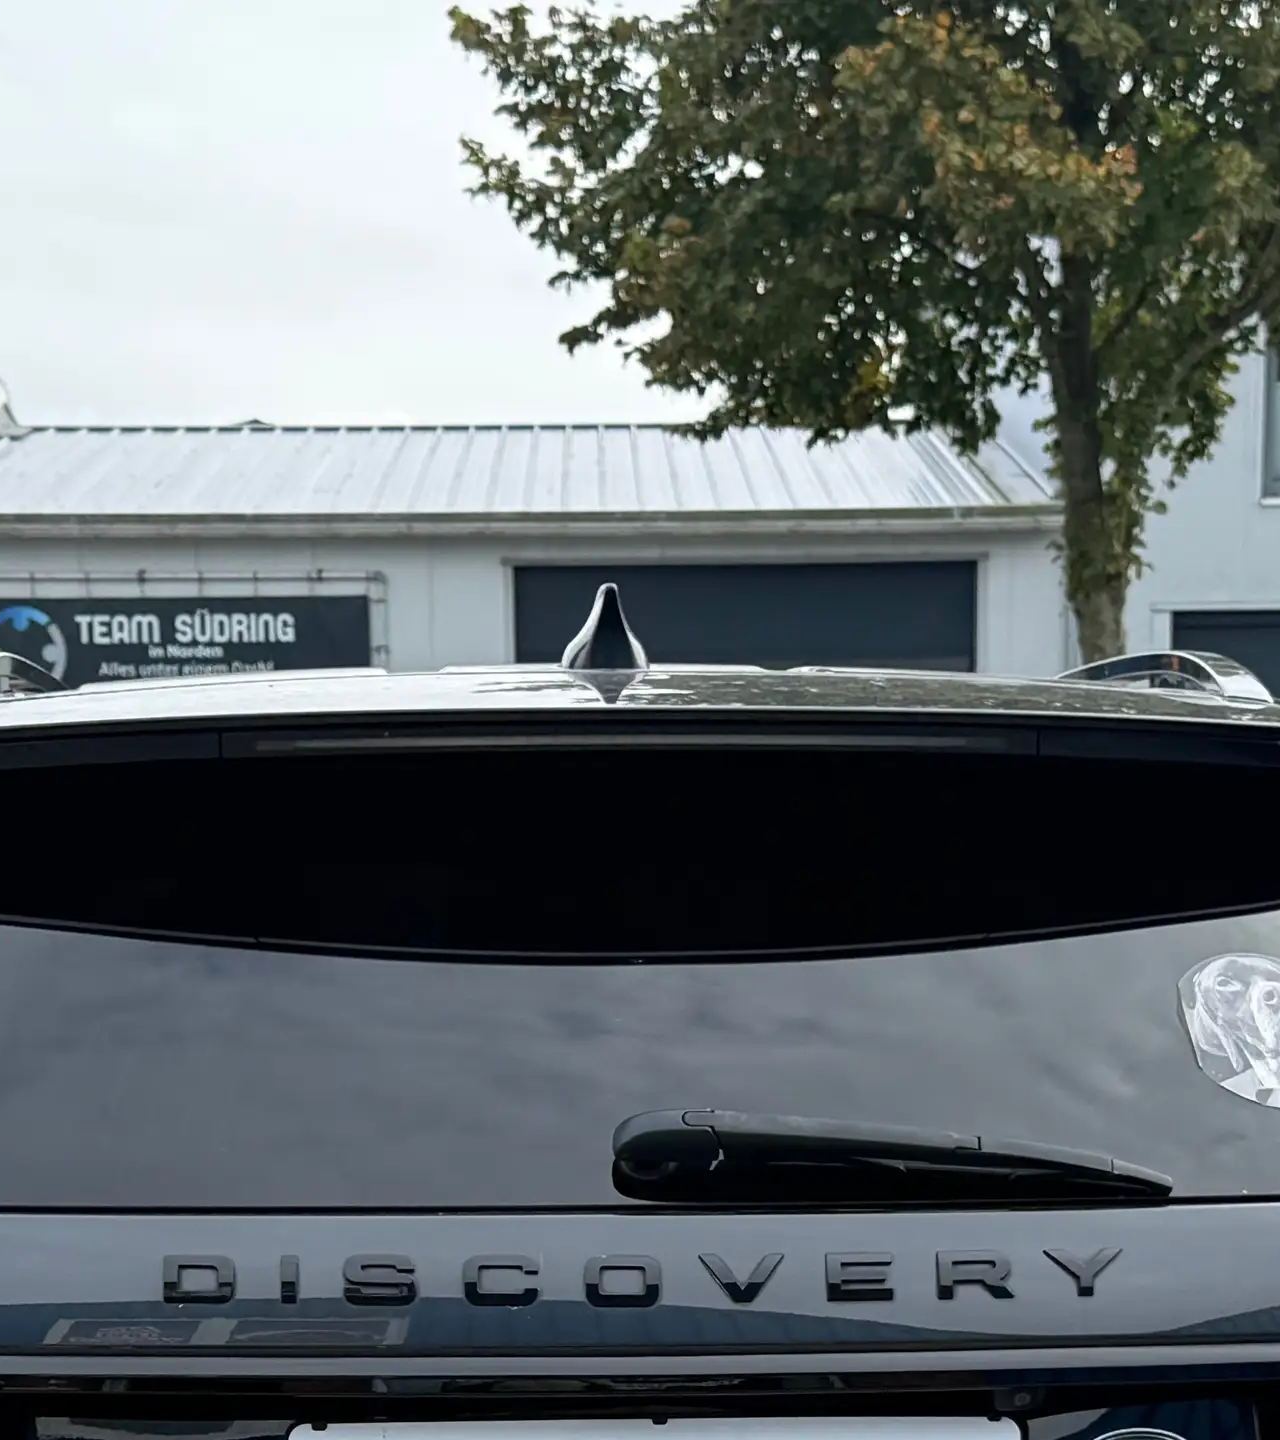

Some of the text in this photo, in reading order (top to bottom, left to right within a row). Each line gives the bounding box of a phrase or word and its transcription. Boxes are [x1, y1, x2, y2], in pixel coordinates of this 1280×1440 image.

[74, 607, 296, 645] TEAM SÜDRING
[148, 643, 224, 658] in Norden
[98, 661, 136, 678] Alles
[163, 1248, 1123, 1307] DISCOVERY
